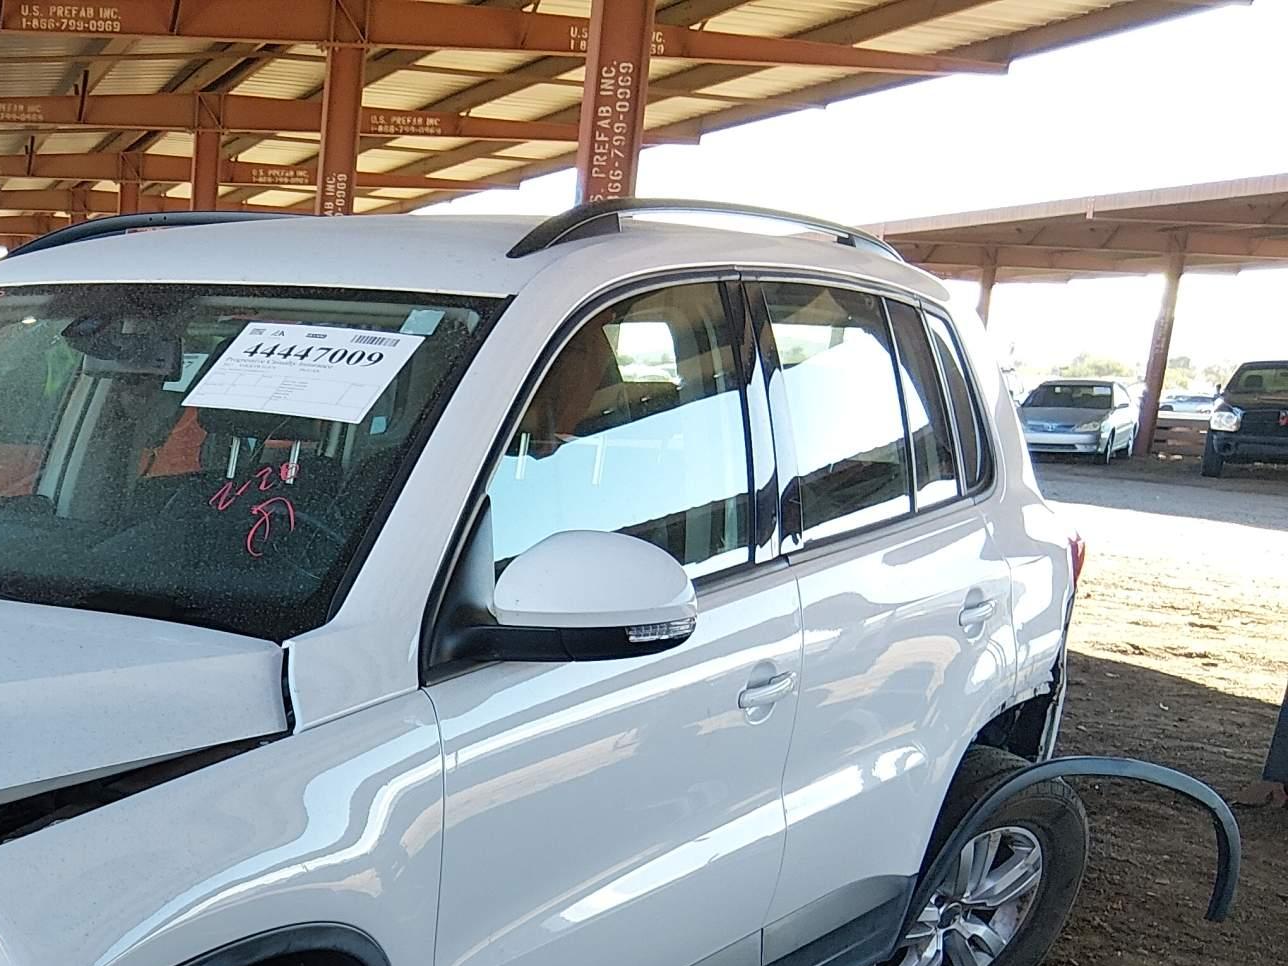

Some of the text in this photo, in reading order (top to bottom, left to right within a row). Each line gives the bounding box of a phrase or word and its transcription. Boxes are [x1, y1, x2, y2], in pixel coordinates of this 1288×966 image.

[20, 4, 122, 20] U.S. PREFAB INC.
[599, 60, 617, 96] INC.
[591, 105, 613, 179] PREFAB
[242, 342, 384, 368] 44447009
